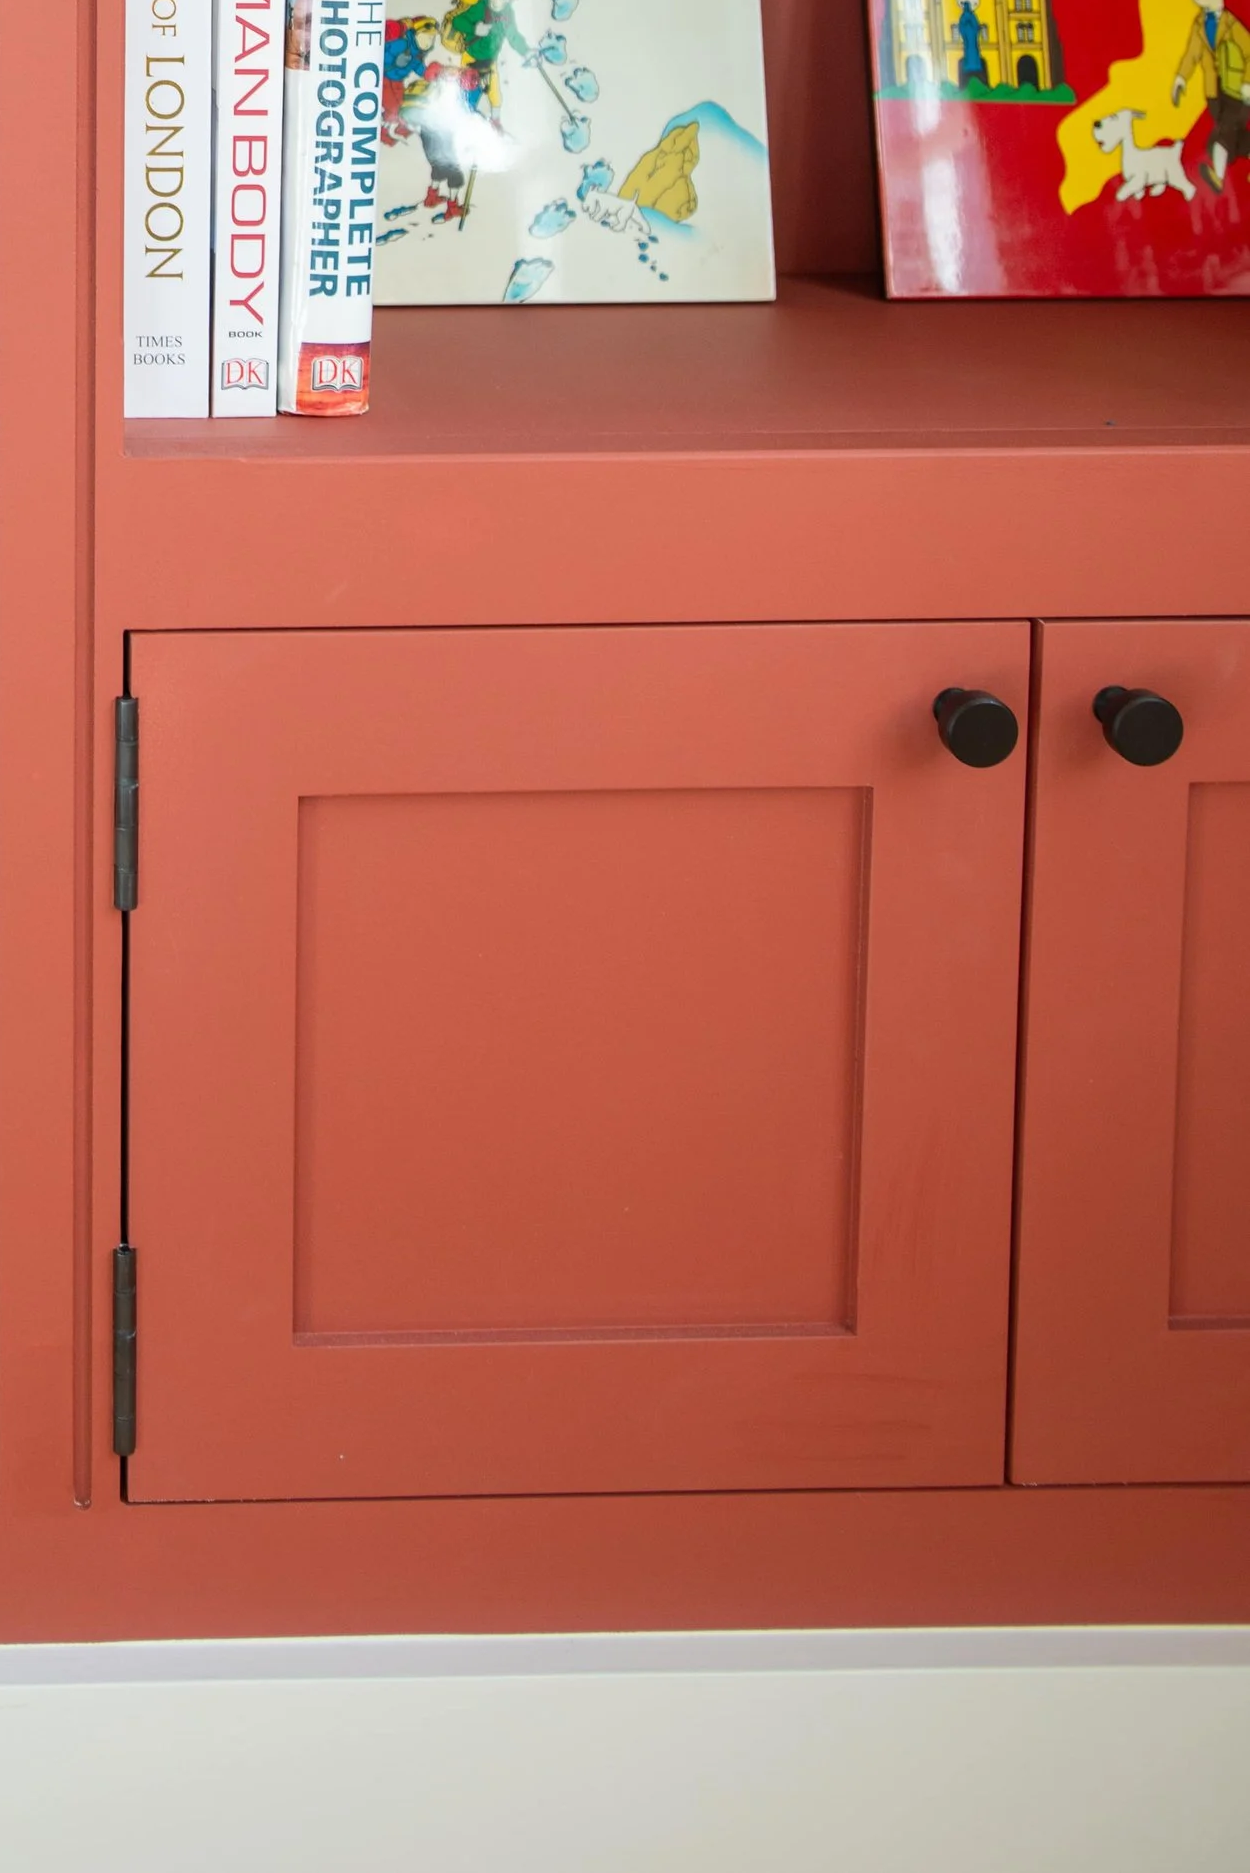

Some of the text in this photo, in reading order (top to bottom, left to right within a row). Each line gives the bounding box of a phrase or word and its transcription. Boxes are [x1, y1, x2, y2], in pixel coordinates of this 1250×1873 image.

[143, 53, 187, 281] LONDON
[344, 59, 383, 298] COMPLETE
[228, 135, 269, 326] BODY
[133, 352, 186, 366] BOOKS
[135, 335, 184, 349] TIMES
[228, 330, 264, 339] BOOK
